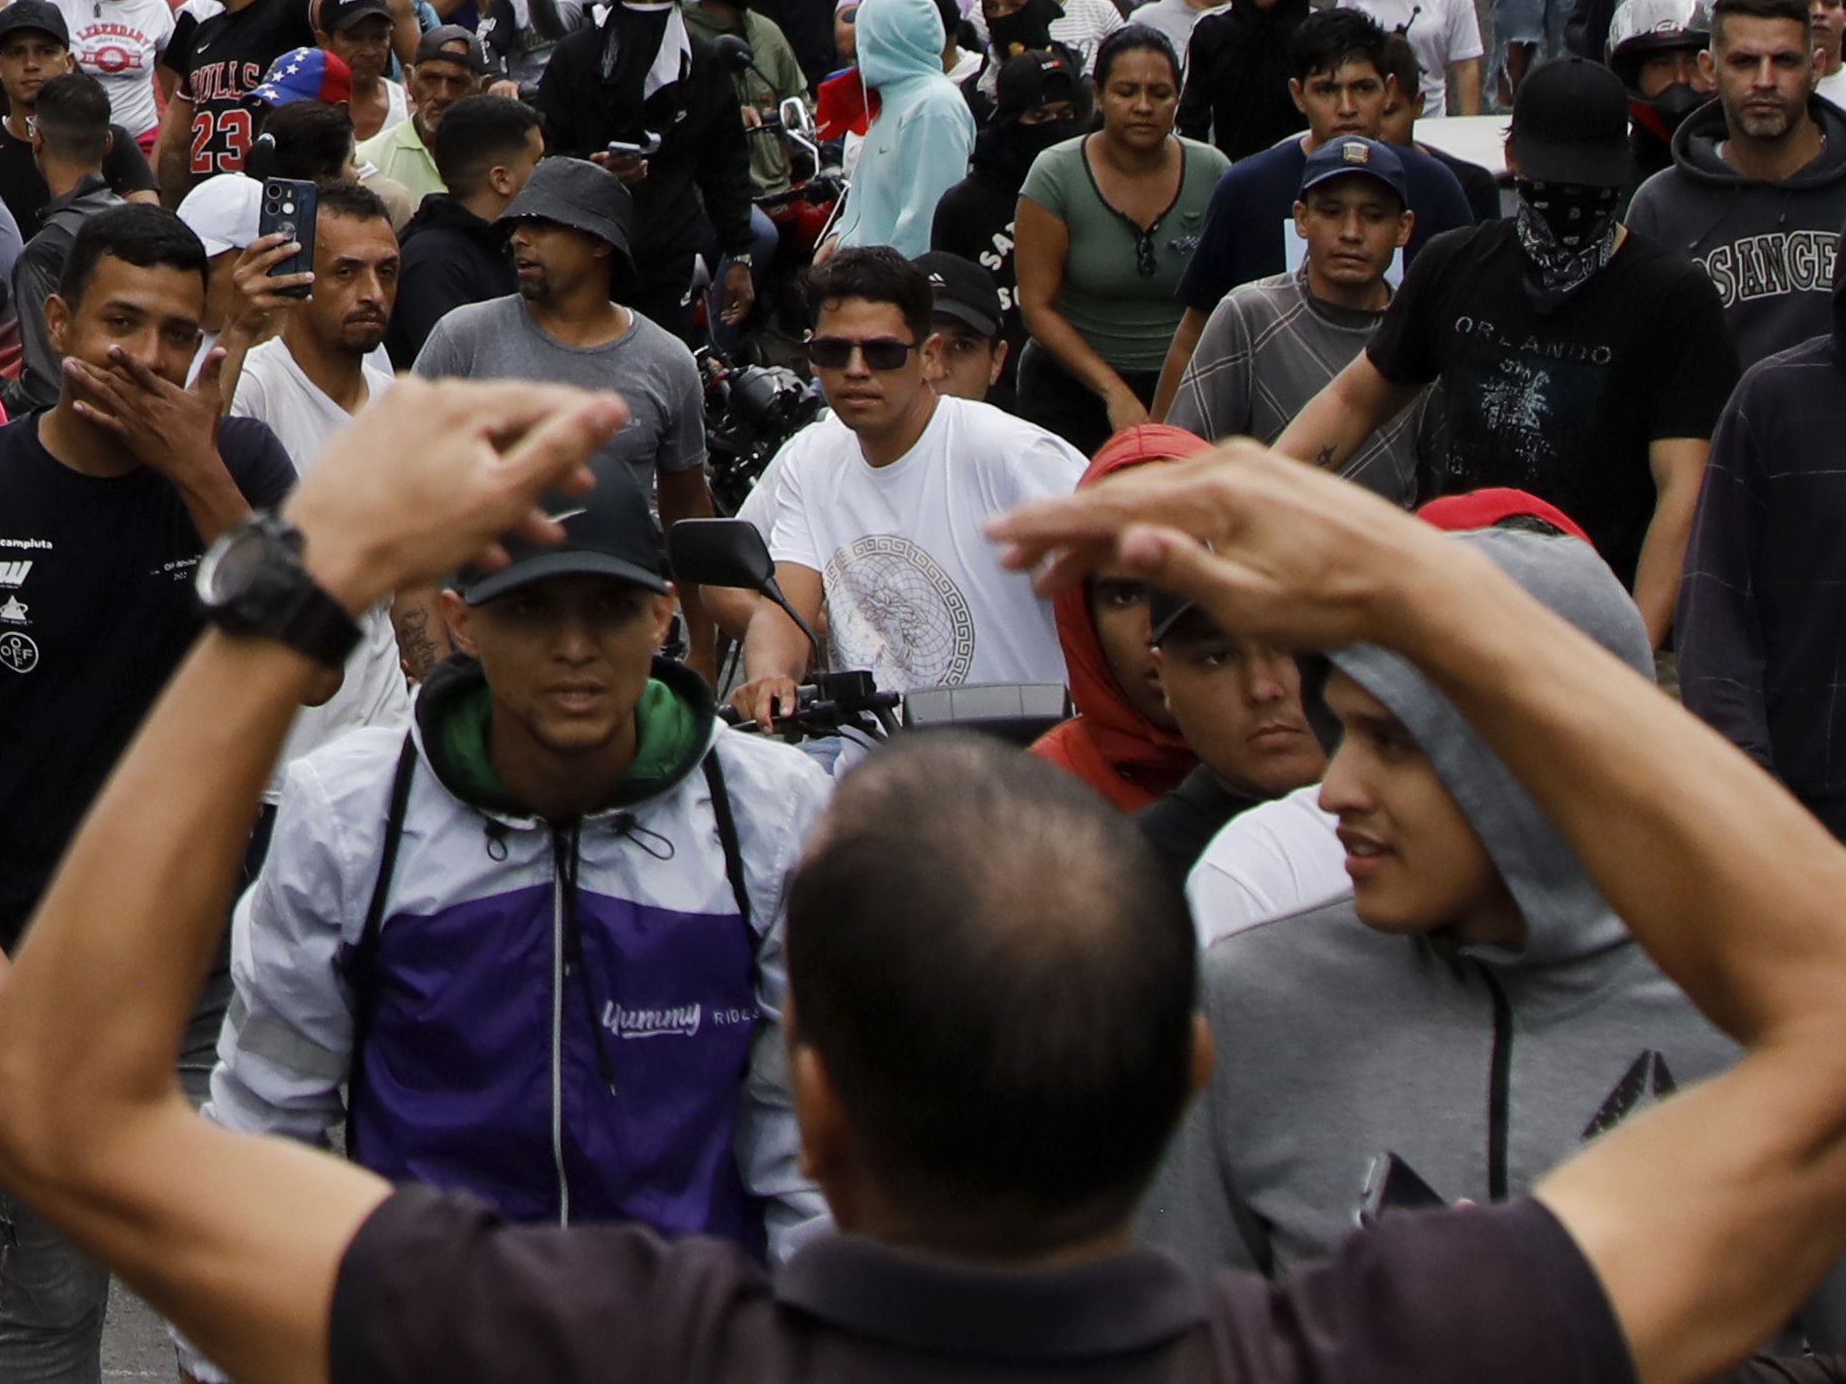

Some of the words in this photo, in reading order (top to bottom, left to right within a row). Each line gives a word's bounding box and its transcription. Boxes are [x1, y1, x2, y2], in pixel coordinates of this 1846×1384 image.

[190, 107, 253, 173] 23
[1453, 315, 1613, 366] ORLANDO
[601, 1001, 701, 1039] Yummy
